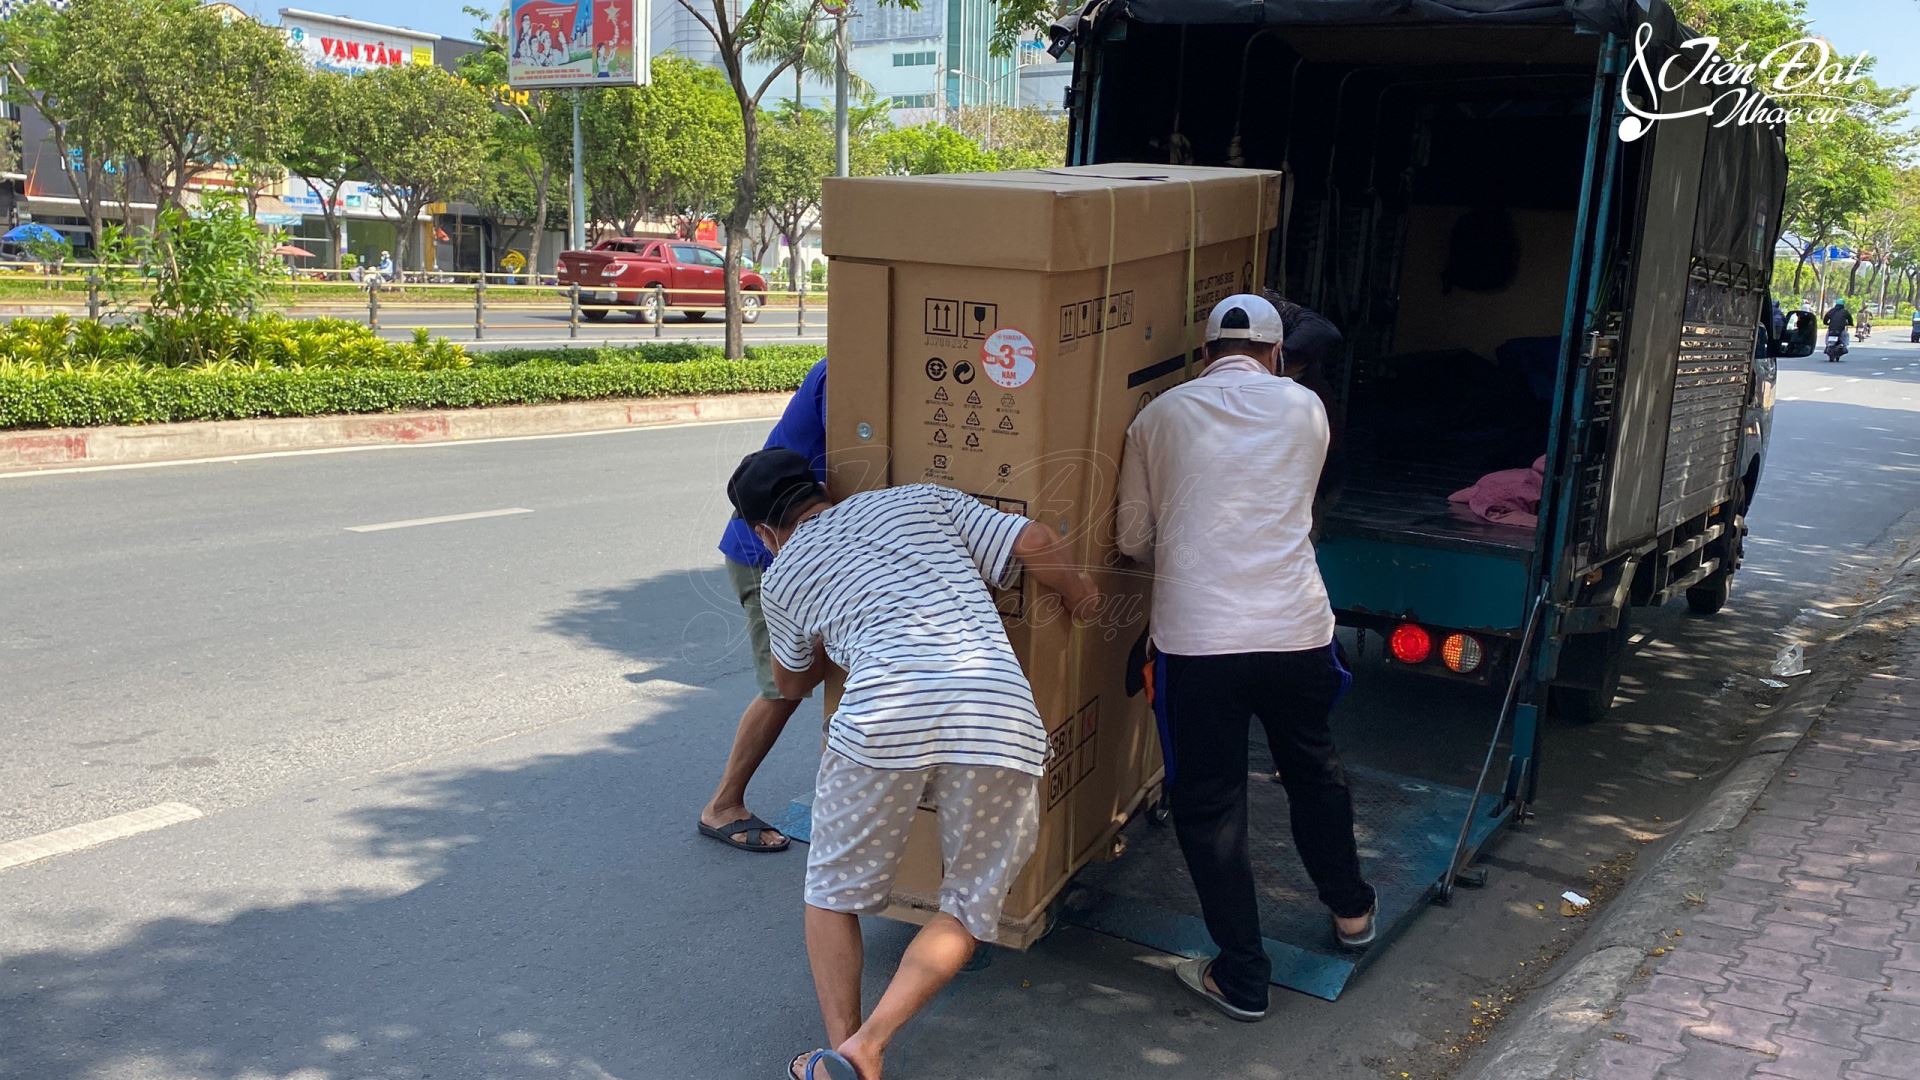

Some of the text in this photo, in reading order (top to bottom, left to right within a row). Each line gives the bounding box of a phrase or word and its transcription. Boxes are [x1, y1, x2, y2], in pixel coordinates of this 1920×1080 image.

[321, 37, 402, 65] VẠN TÂM
[999, 344, 1016, 369] 3
